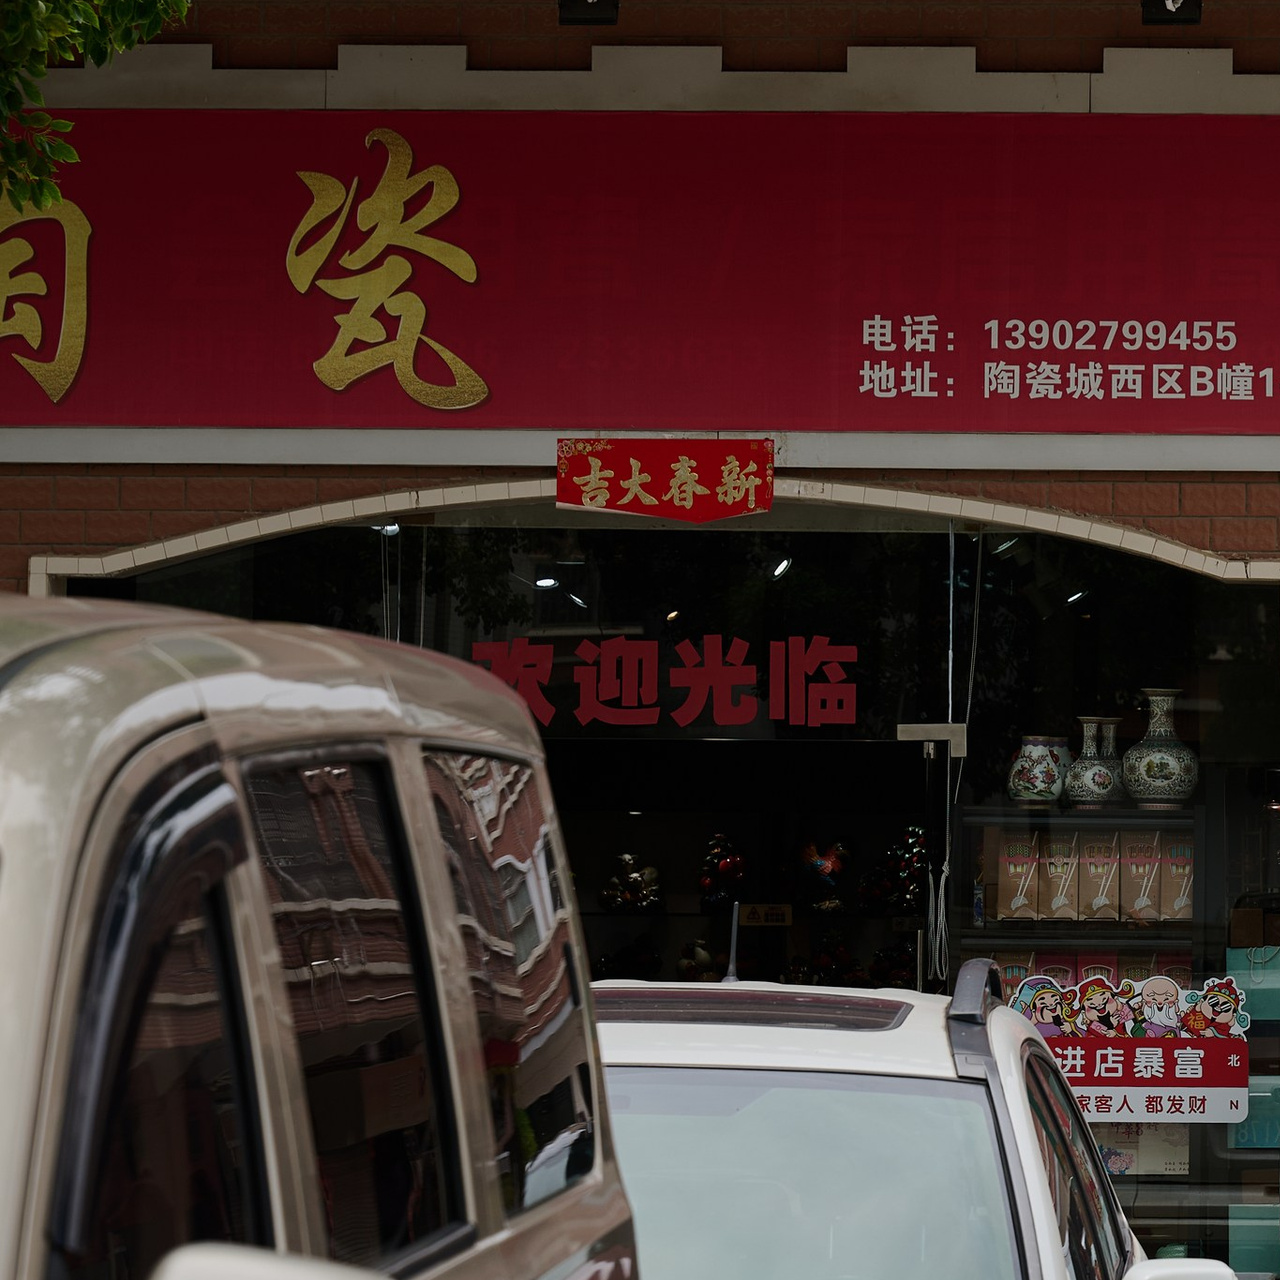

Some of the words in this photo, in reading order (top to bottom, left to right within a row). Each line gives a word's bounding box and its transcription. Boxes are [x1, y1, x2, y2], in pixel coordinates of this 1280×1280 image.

[984, 320, 1238, 350] 13902799455
[472, 634, 859, 728] 欢迎光临
[1187, 1012, 1206, 1030] 福
[1055, 1046, 1205, 1079] 进店暴富
[1227, 1054, 1241, 1067] 北
[1145, 1094, 1208, 1115] 都发财
[1229, 1100, 1239, 1110] N
